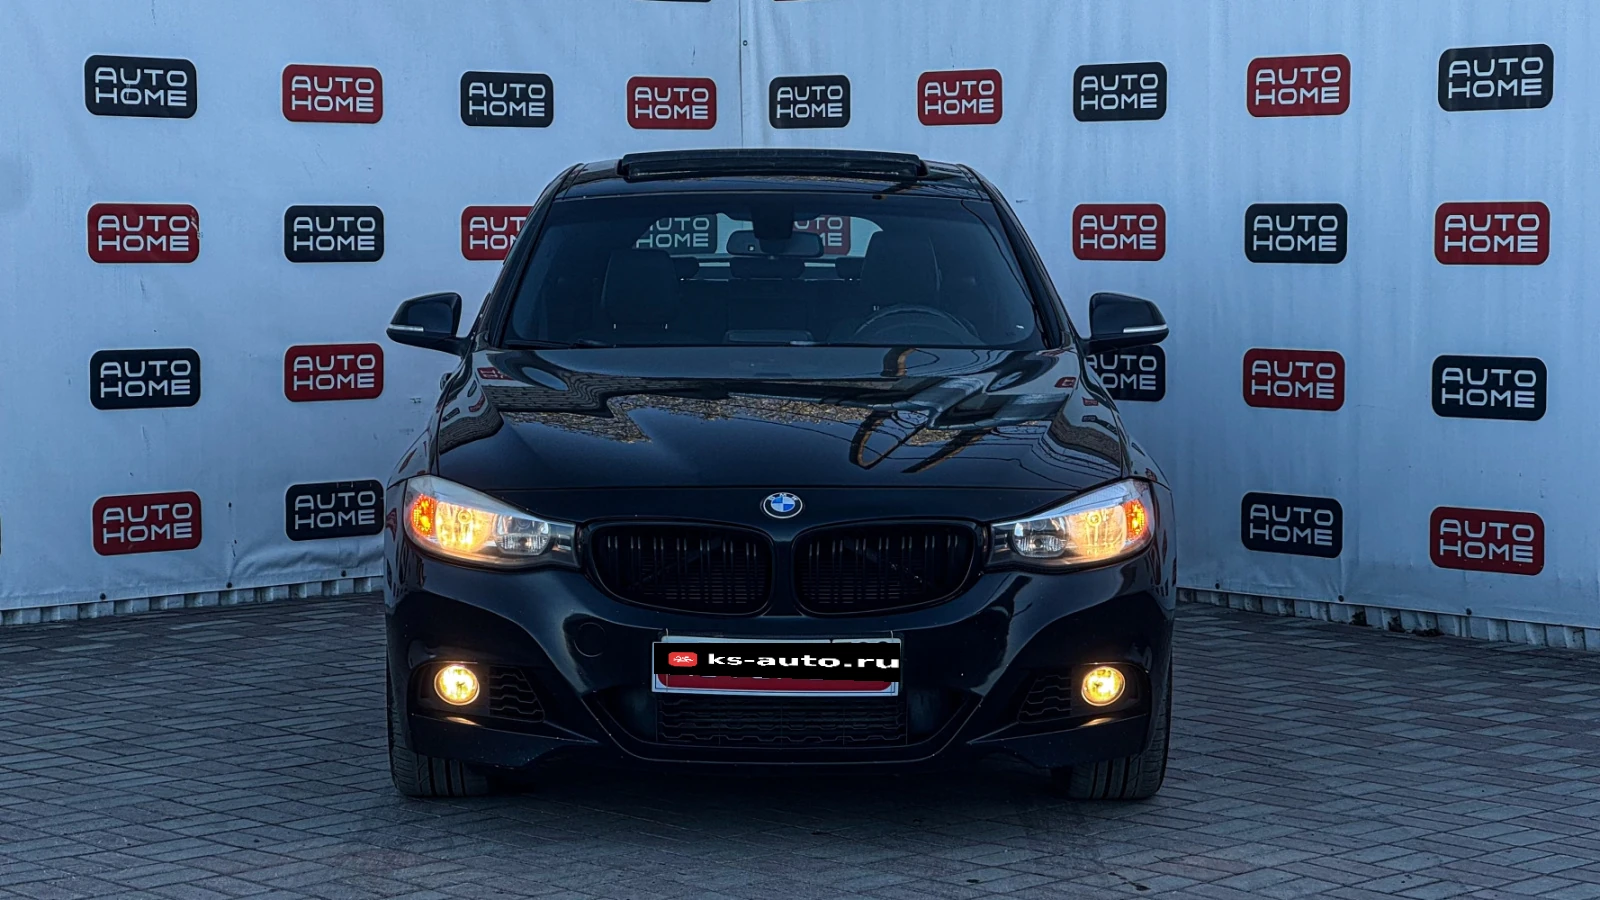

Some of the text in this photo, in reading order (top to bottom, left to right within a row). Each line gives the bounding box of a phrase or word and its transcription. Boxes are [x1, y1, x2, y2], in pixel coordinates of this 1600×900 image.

[1256, 66, 1341, 86] AUTO
[1449, 57, 1543, 78] AUTO
[95, 67, 187, 87] AUTO
[292, 76, 374, 94] AUTO
[1081, 74, 1158, 91] AUTO
[95, 87, 187, 106] HOME
[469, 82, 546, 99] AUTO
[635, 87, 709, 102] AUTO
[777, 85, 843, 101] AUTO
[925, 80, 995, 97] AUTO
[1255, 86, 1340, 105] HOME
[1448, 78, 1542, 99] HOME
[292, 95, 374, 113] HOME
[469, 100, 545, 117] HOME
[925, 98, 994, 115] HOME
[1081, 93, 1157, 110] HOME
[635, 104, 708, 119] HOME
[776, 103, 842, 118] HOME
[98, 215, 190, 232] AUTO
[294, 217, 376, 232] AUTO
[470, 216, 526, 231] AUT
[651, 217, 710, 231] UTO
[795, 217, 843, 230] UTO
[1080, 215, 1157, 231] AUTO
[1254, 215, 1338, 232] AUTO
[1445, 214, 1540, 231] AUTO
[98, 235, 189, 251] HOME
[294, 235, 375, 251] HOME
[470, 234, 516, 250] HO
[1080, 234, 1156, 250] HOME
[1253, 235, 1337, 251] HOME
[1444, 235, 1538, 252] HOME
[100, 360, 191, 378] AUTO
[294, 354, 376, 372] AUTO
[1252, 360, 1336, 379] AUTO
[294, 373, 374, 391] HOME
[1101, 373, 1156, 390] OME
[1442, 367, 1536, 387] AUTO
[100, 379, 190, 398] HOME
[1251, 379, 1334, 399] HOME
[1442, 388, 1535, 408] HOME
[295, 491, 376, 511] AUTO
[103, 503, 192, 524] AUTO
[295, 509, 375, 530] HOME
[1250, 504, 1334, 526] AUTO
[103, 522, 192, 544] HOME
[1250, 523, 1332, 546] HOME
[1440, 519, 1534, 542] AUTO
[1440, 539, 1533, 563] HOME
